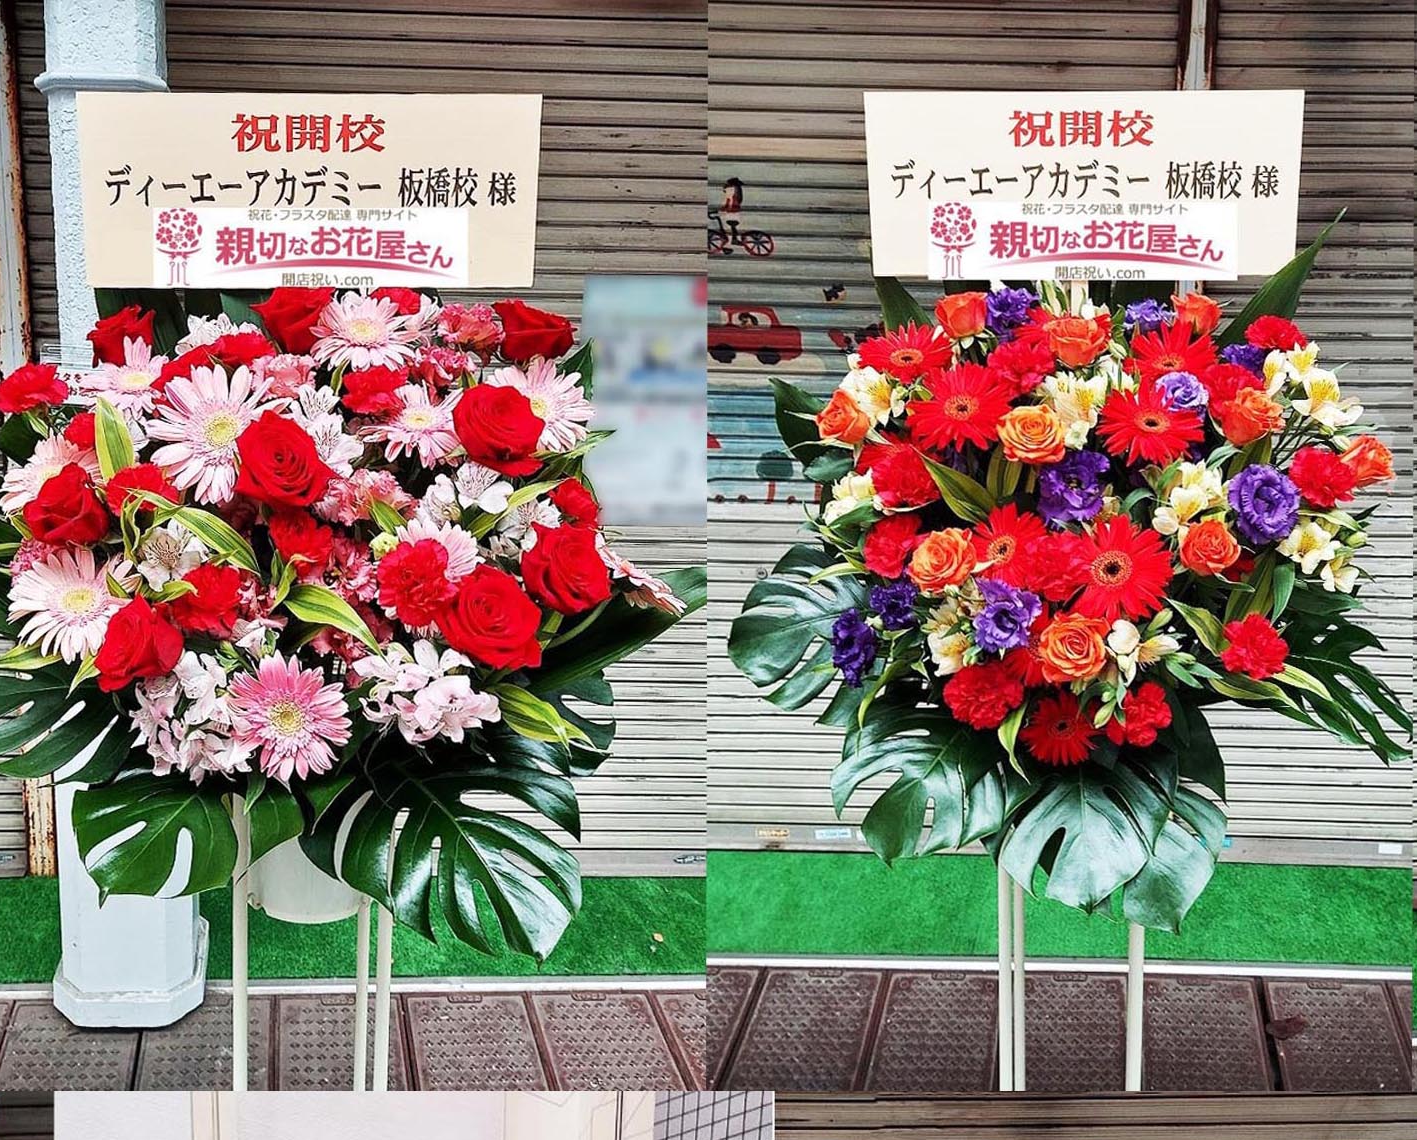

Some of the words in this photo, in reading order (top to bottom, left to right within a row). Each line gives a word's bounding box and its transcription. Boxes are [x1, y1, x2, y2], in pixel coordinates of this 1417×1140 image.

[233, 114, 385, 153] 祝開校
[1010, 111, 1153, 147] 祝開校
[106, 165, 381, 206] ディーエーアカデミー
[398, 167, 478, 207] 板橋校
[488, 173, 516, 206] 様
[892, 160, 1149, 199] ディーエーアカデミー
[1166, 161, 1242, 199] 板橋校
[1252, 166, 1278, 198] 様
